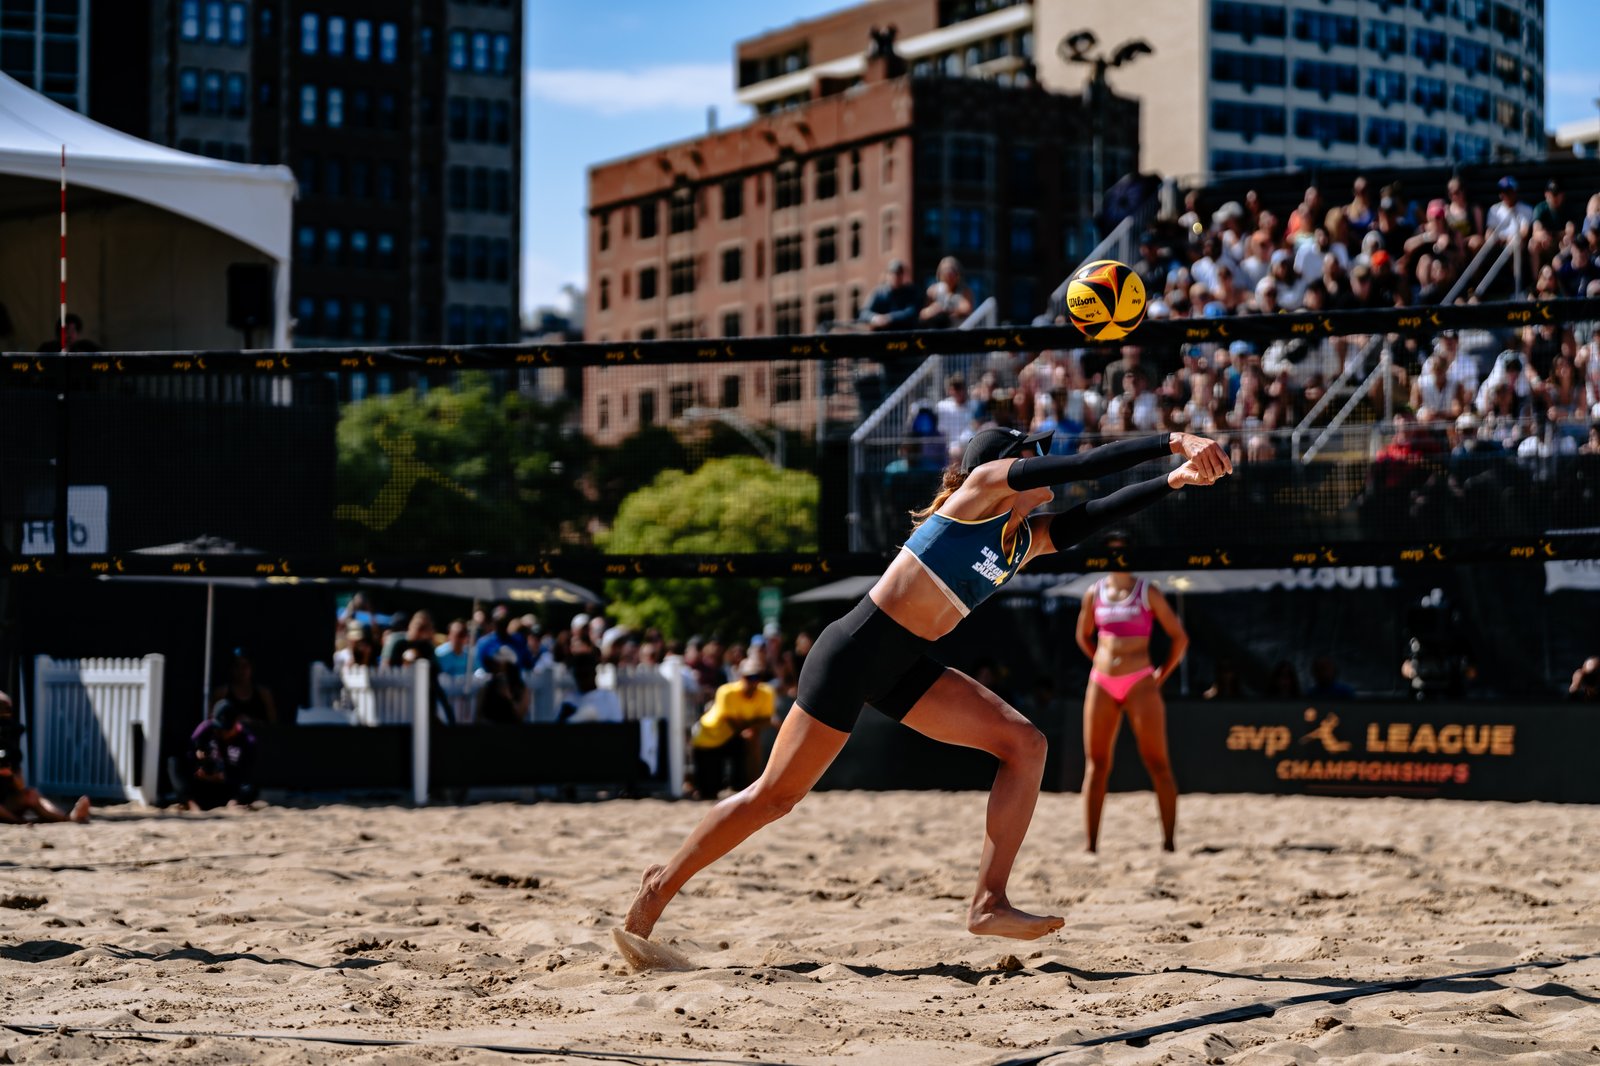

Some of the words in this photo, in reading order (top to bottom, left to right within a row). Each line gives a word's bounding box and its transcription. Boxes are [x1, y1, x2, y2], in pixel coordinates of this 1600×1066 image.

[1069, 296, 1096, 308] Wilson
[1507, 310, 1531, 322] avp
[1292, 323, 1314, 333] avp
[1398, 318, 1421, 328] avp
[1186, 328, 1209, 338] avp
[980, 545, 999, 563] SAN
[1400, 550, 1425, 561] avp
[1510, 546, 1535, 558] avp
[1086, 558, 1108, 568] avp
[1188, 556, 1212, 566] avp
[1293, 553, 1316, 564] avp
[12, 563, 29, 573] avp
[91, 562, 109, 572] avp
[172, 563, 191, 573] avp
[256, 564, 275, 574] avp
[341, 565, 360, 575] avp
[428, 565, 447, 575] avp
[517, 565, 535, 575] avp
[607, 564, 626, 574] avp
[699, 563, 718, 573] avp
[793, 563, 812, 573] avp
[982, 558, 1003, 577] DIEGO
[1226, 725, 1292, 758] avp
[1366, 723, 1516, 755] LEAGUE
[1276, 759, 1470, 783] CHAMPIONSHIPS
